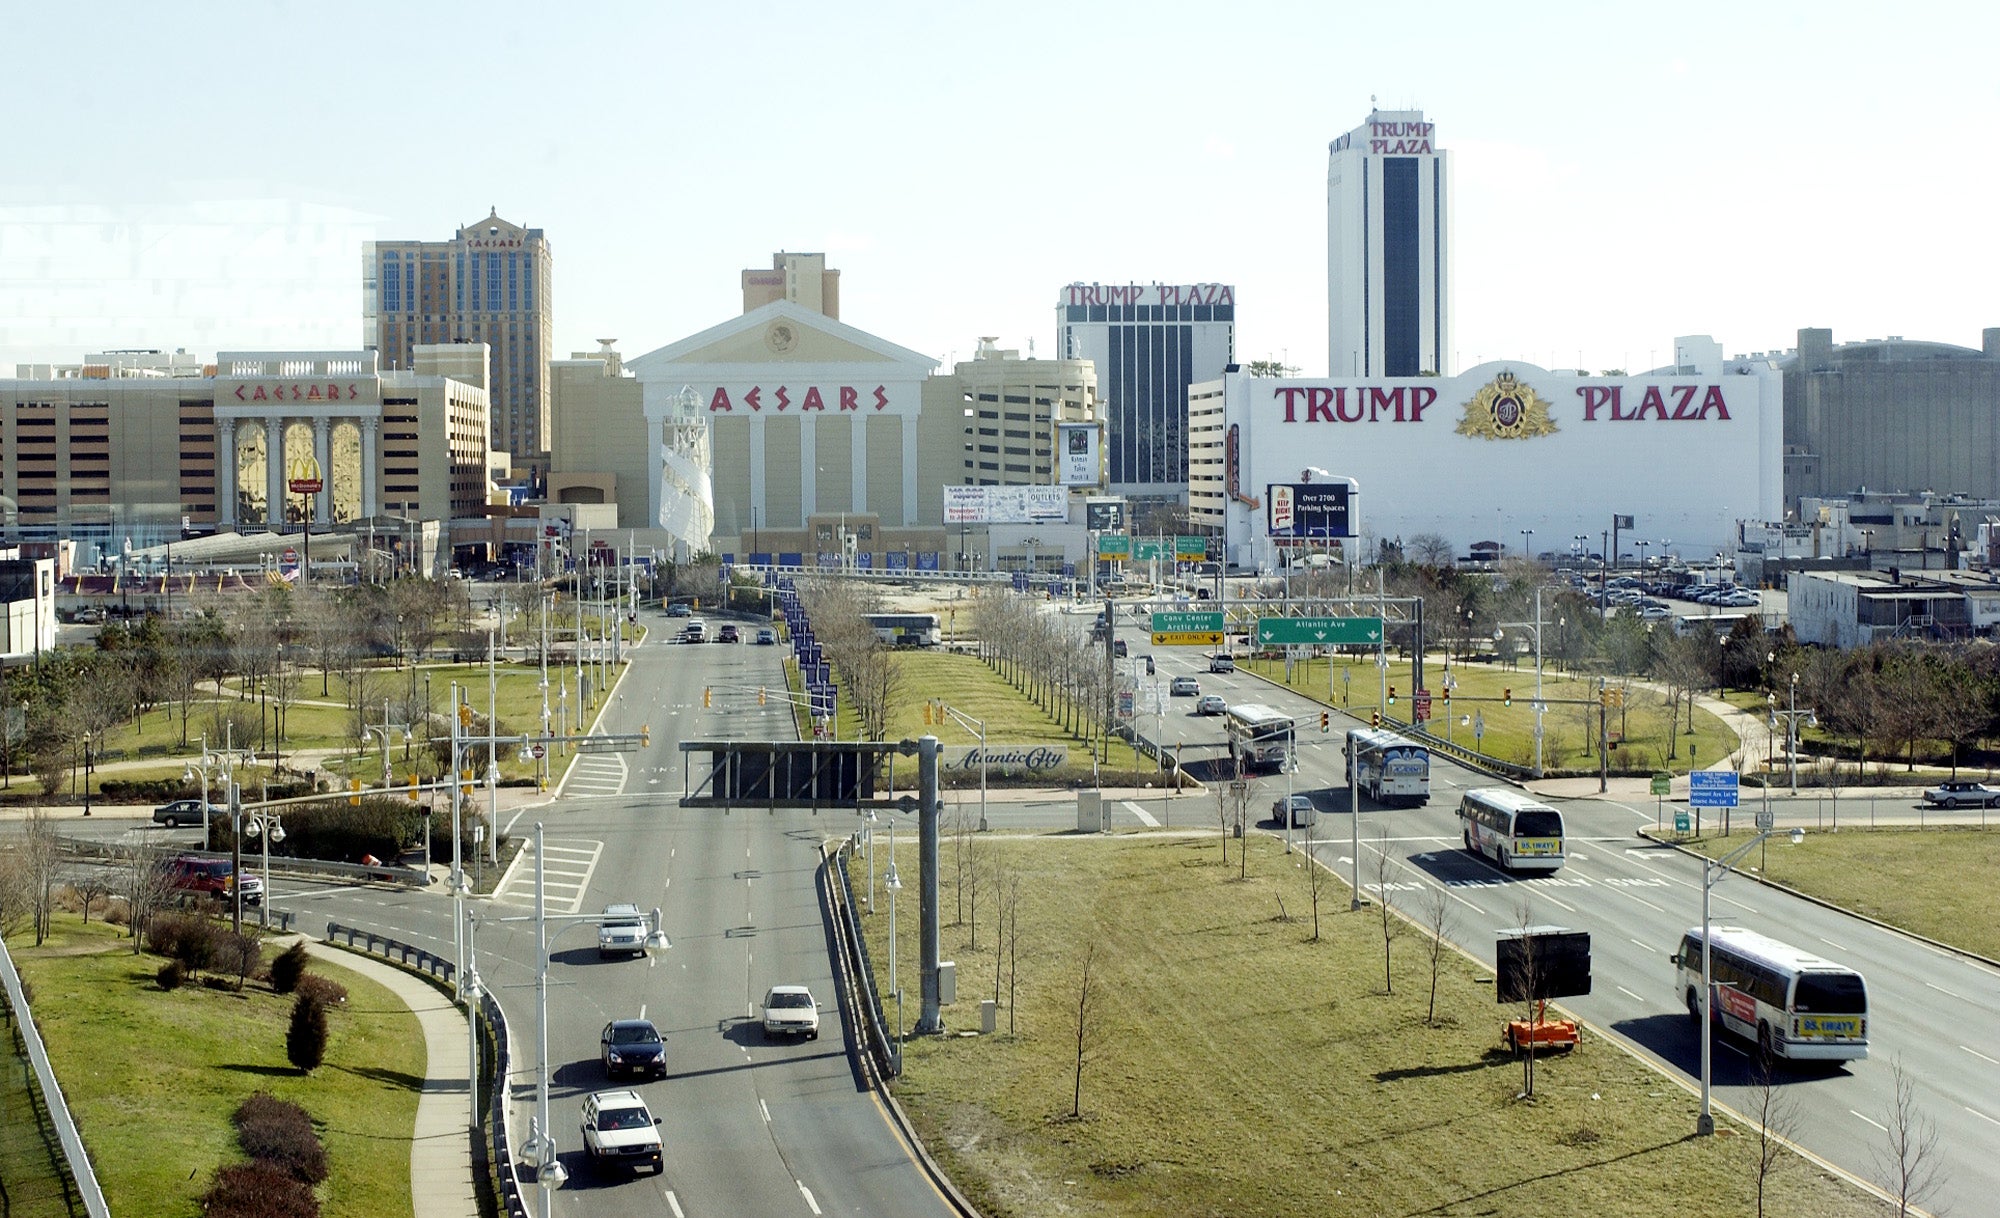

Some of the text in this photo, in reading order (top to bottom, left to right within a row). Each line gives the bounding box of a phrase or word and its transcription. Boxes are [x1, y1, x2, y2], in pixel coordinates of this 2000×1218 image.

[1369, 122, 1433, 137] TRUMP
[1369, 140, 1432, 154] PLAZA
[1066, 286, 1233, 305] TRUMP PLAZA
[235, 384, 357, 400] CAESARS
[709, 385, 889, 412] AESARS
[1274, 385, 1731, 423] TRUMP PLAZA
[1031, 493, 1060, 501] OUTLETS
[1323, 504, 1345, 512] Spaces
[1025, 747, 1064, 769] City
[1445, 878, 1510, 888] ONLY
[1604, 877, 1671, 887] ONLY
